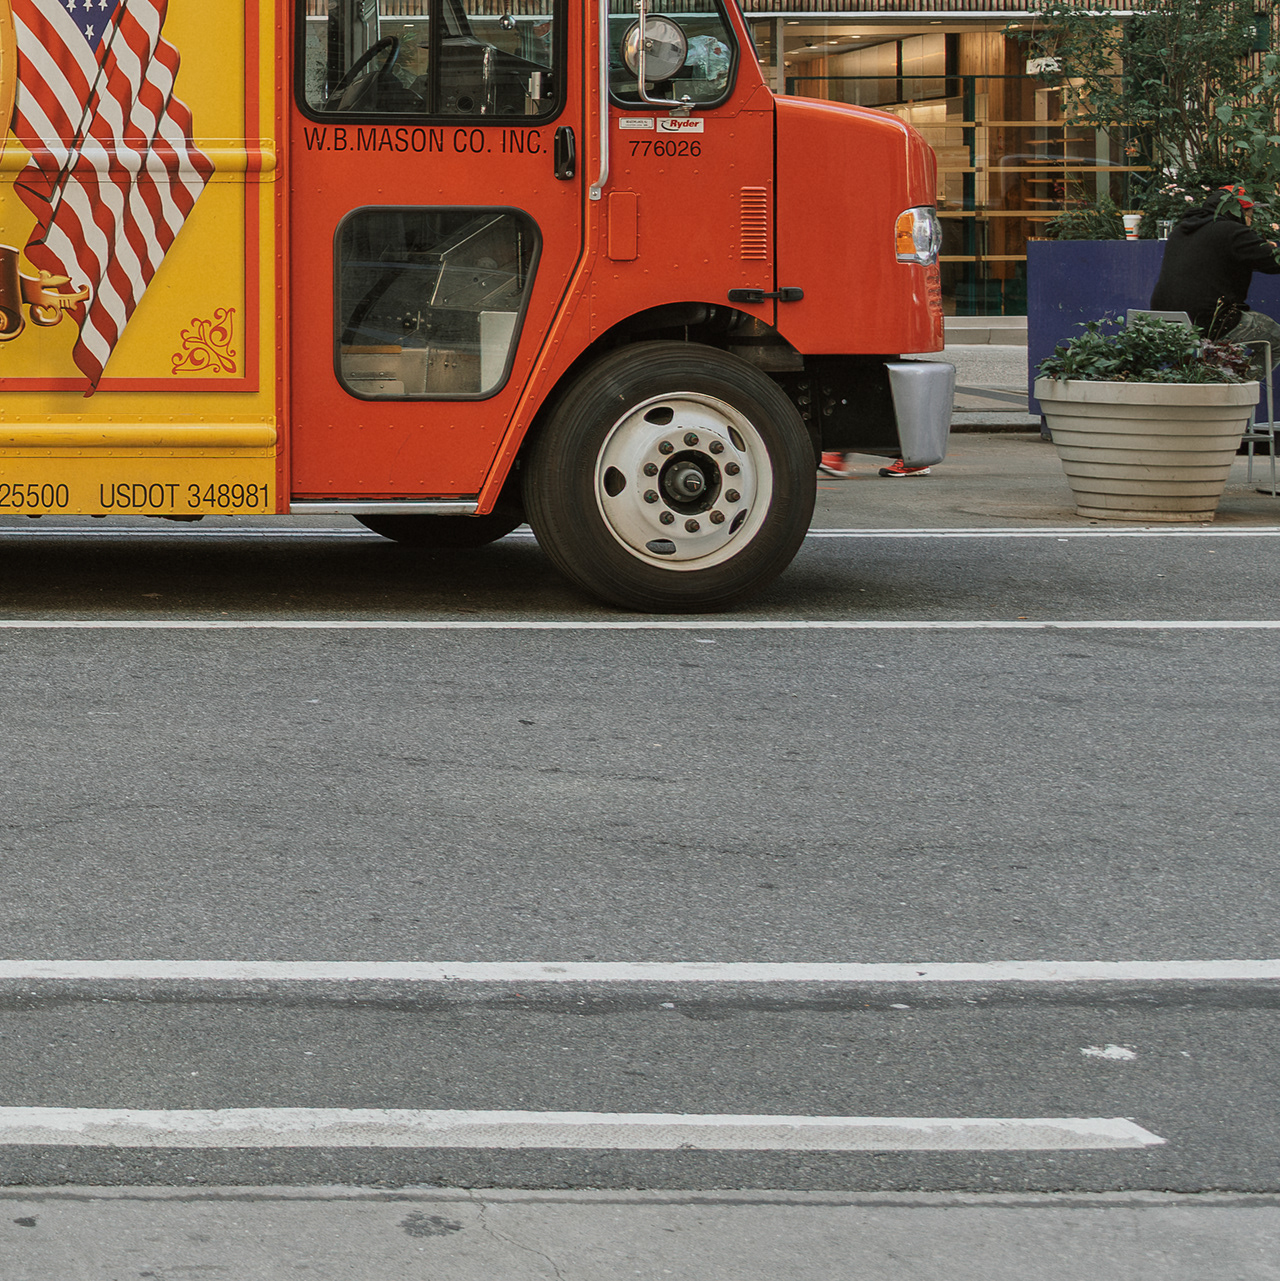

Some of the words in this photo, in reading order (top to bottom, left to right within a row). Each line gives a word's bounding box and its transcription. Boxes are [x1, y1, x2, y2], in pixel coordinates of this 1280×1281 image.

[452, 128, 492, 154] CO.
[500, 129, 548, 155] INC.
[629, 140, 702, 157] 776026
[100, 483, 180, 508] USDOT
[187, 483, 270, 508] 348981
